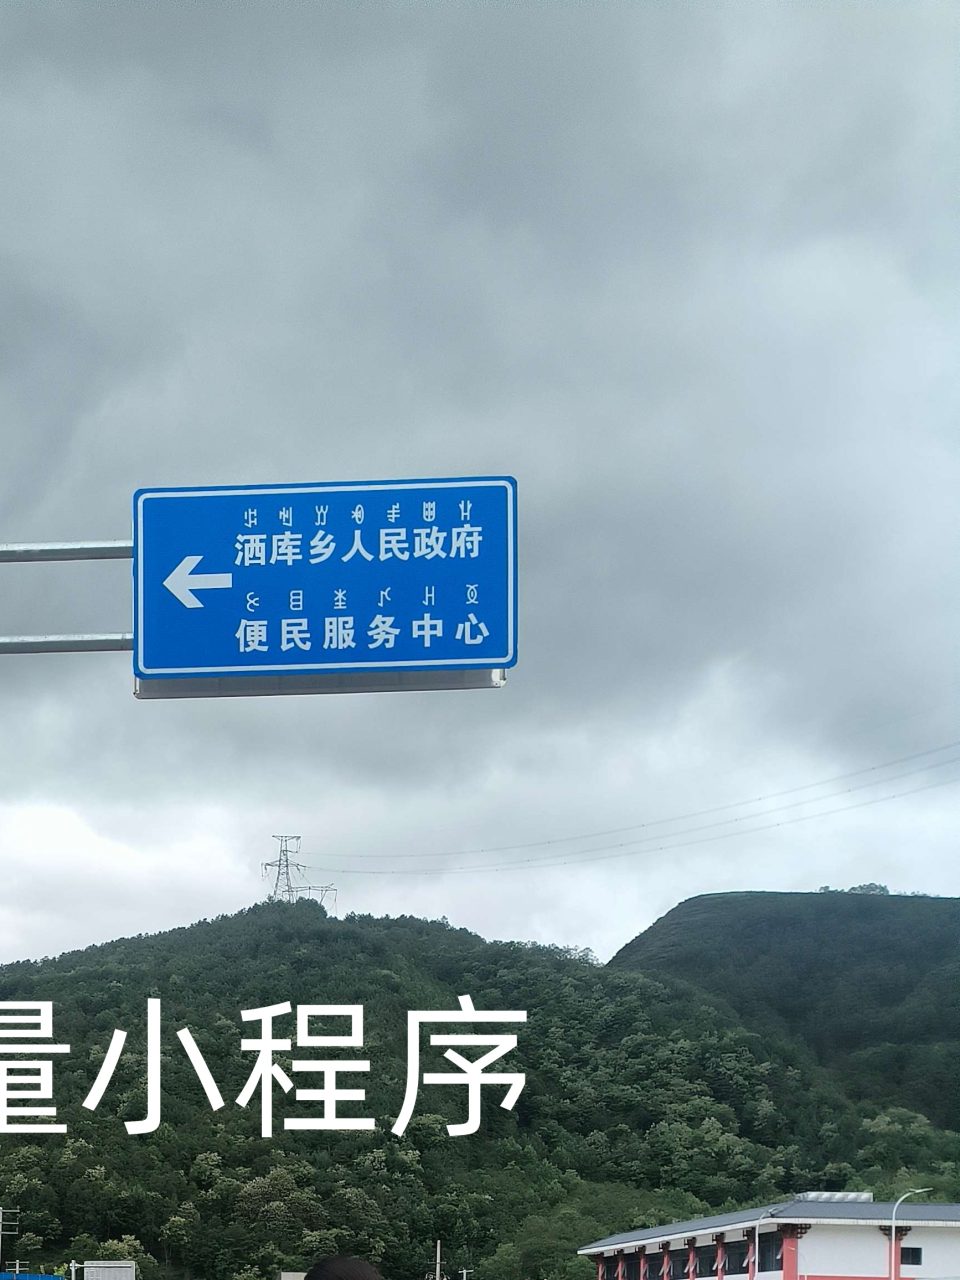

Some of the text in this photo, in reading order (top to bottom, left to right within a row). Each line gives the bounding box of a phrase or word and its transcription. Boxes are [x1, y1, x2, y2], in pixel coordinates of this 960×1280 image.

[234, 524, 483, 567] 洒库乡人民政府
[235, 613, 490, 653] 便民服务中心
